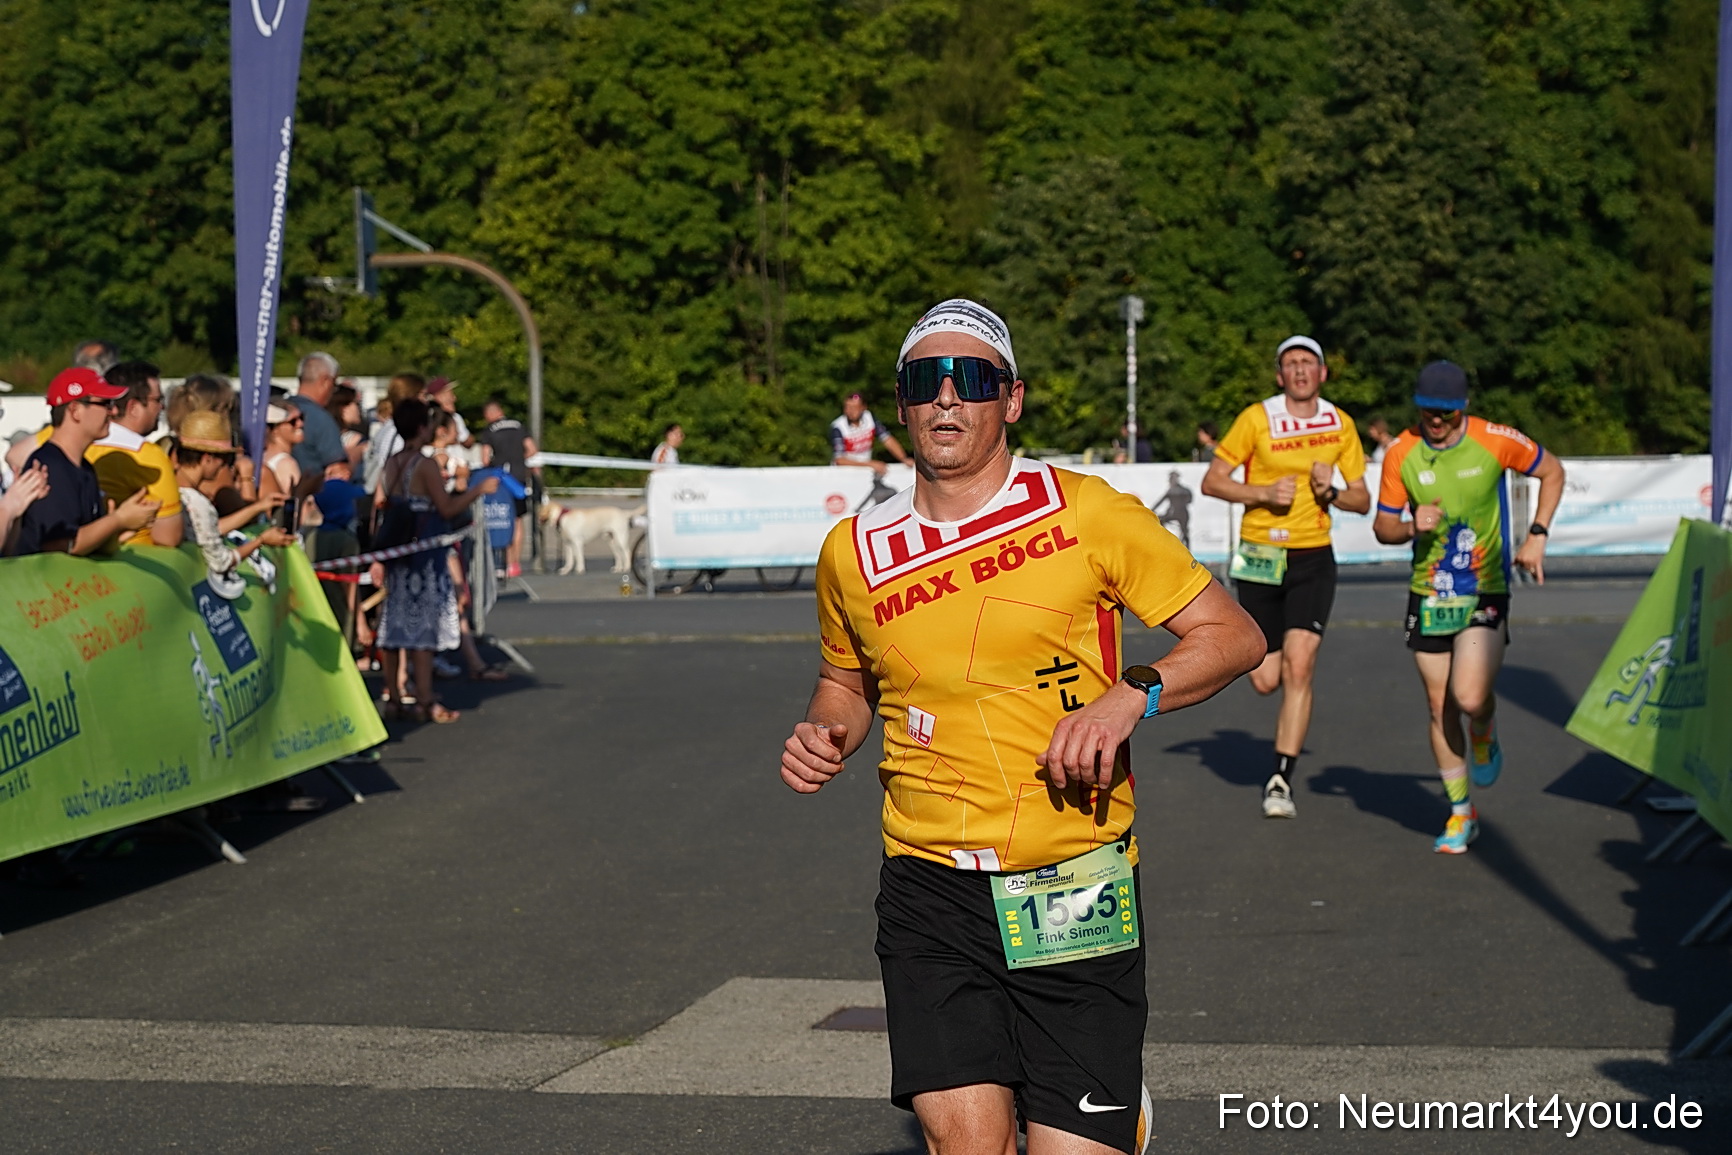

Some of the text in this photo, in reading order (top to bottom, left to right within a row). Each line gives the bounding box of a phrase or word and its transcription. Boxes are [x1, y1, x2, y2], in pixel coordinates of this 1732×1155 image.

[873, 525, 1079, 628] MAX BÖGL
[1436, 607, 1464, 620] 611
[1029, 872, 1075, 888] Firmenlauf
[1118, 884, 1133, 935] 2022
[1005, 910, 1024, 947] RUN
[1036, 924, 1110, 945] Fink Simon
